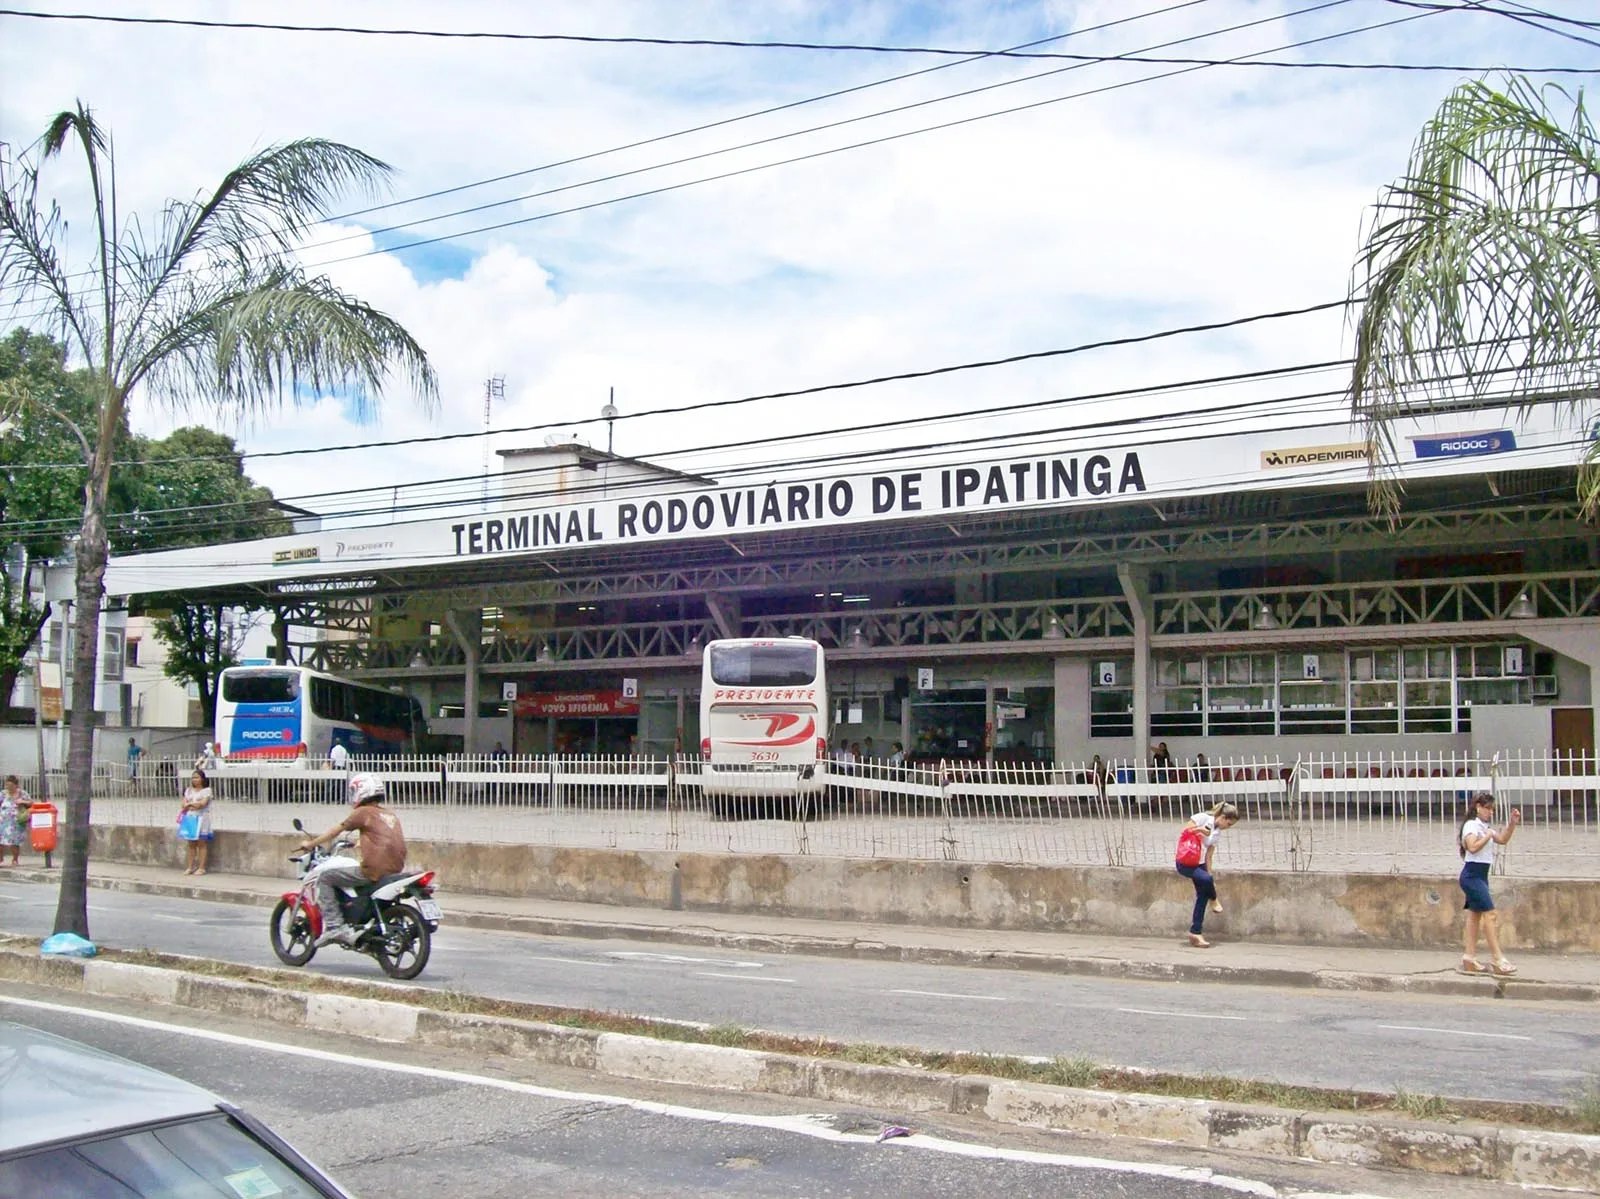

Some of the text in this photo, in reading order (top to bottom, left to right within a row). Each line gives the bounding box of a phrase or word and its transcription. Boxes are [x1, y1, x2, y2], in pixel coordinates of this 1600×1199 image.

[452, 452, 1147, 554] TERMINAL RODOVIÁRIO DE IPATINGA
[1307, 666, 1316, 677] H
[921, 678, 929, 688] F
[1104, 673, 1113, 683] G
[506, 691, 514, 699] C
[626, 687, 634, 696] D
[714, 689, 816, 700] PRESIDENTE
[751, 751, 779, 761] 3630
